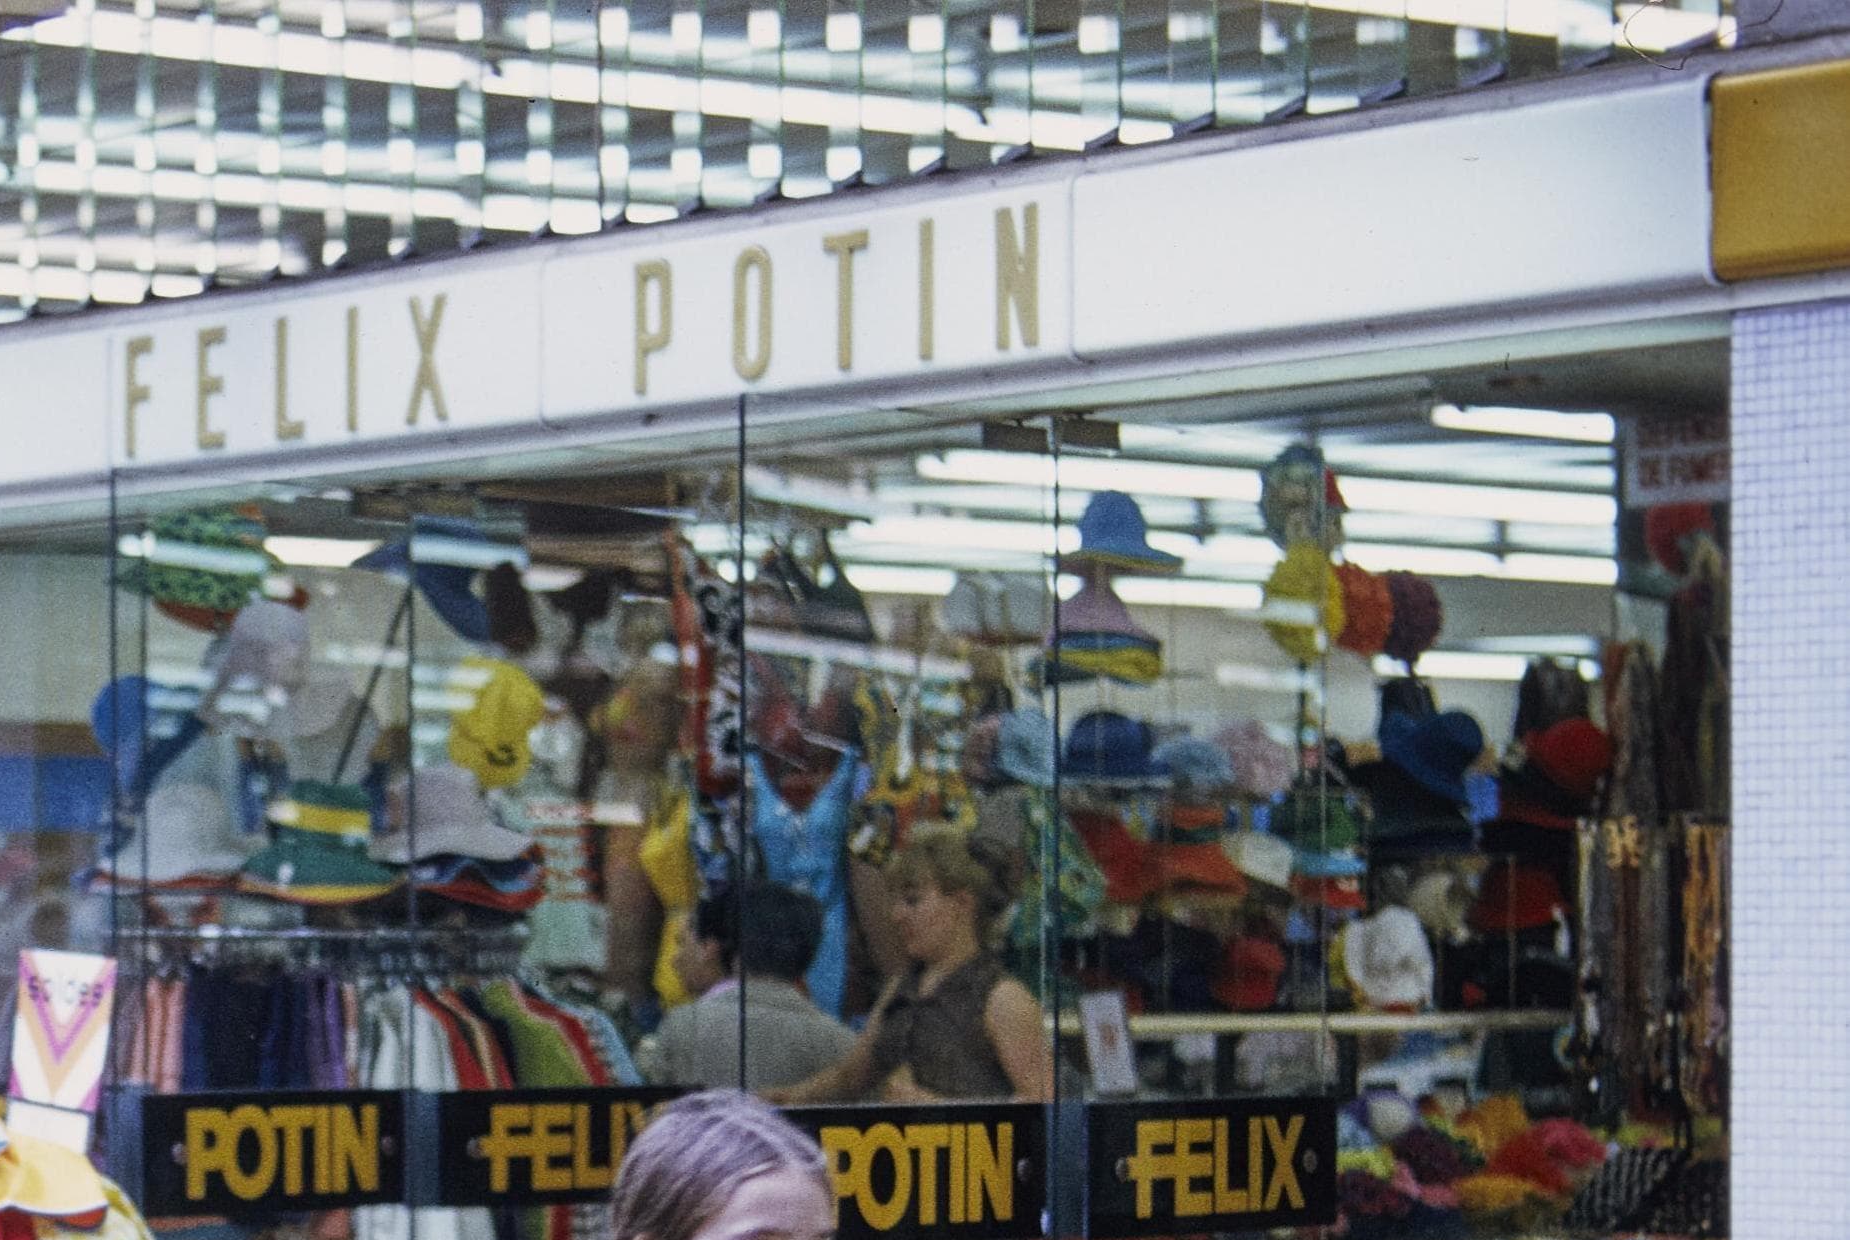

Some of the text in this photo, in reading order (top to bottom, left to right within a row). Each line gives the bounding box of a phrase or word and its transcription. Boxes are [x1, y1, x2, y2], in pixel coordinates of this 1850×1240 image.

[124, 200, 1041, 459] FELIX POTIN
[186, 1105, 379, 1200] POTIN
[480, 1103, 668, 1192] FELI
[819, 1123, 1014, 1231] POTIN
[1126, 1115, 1305, 1220] FELIX
